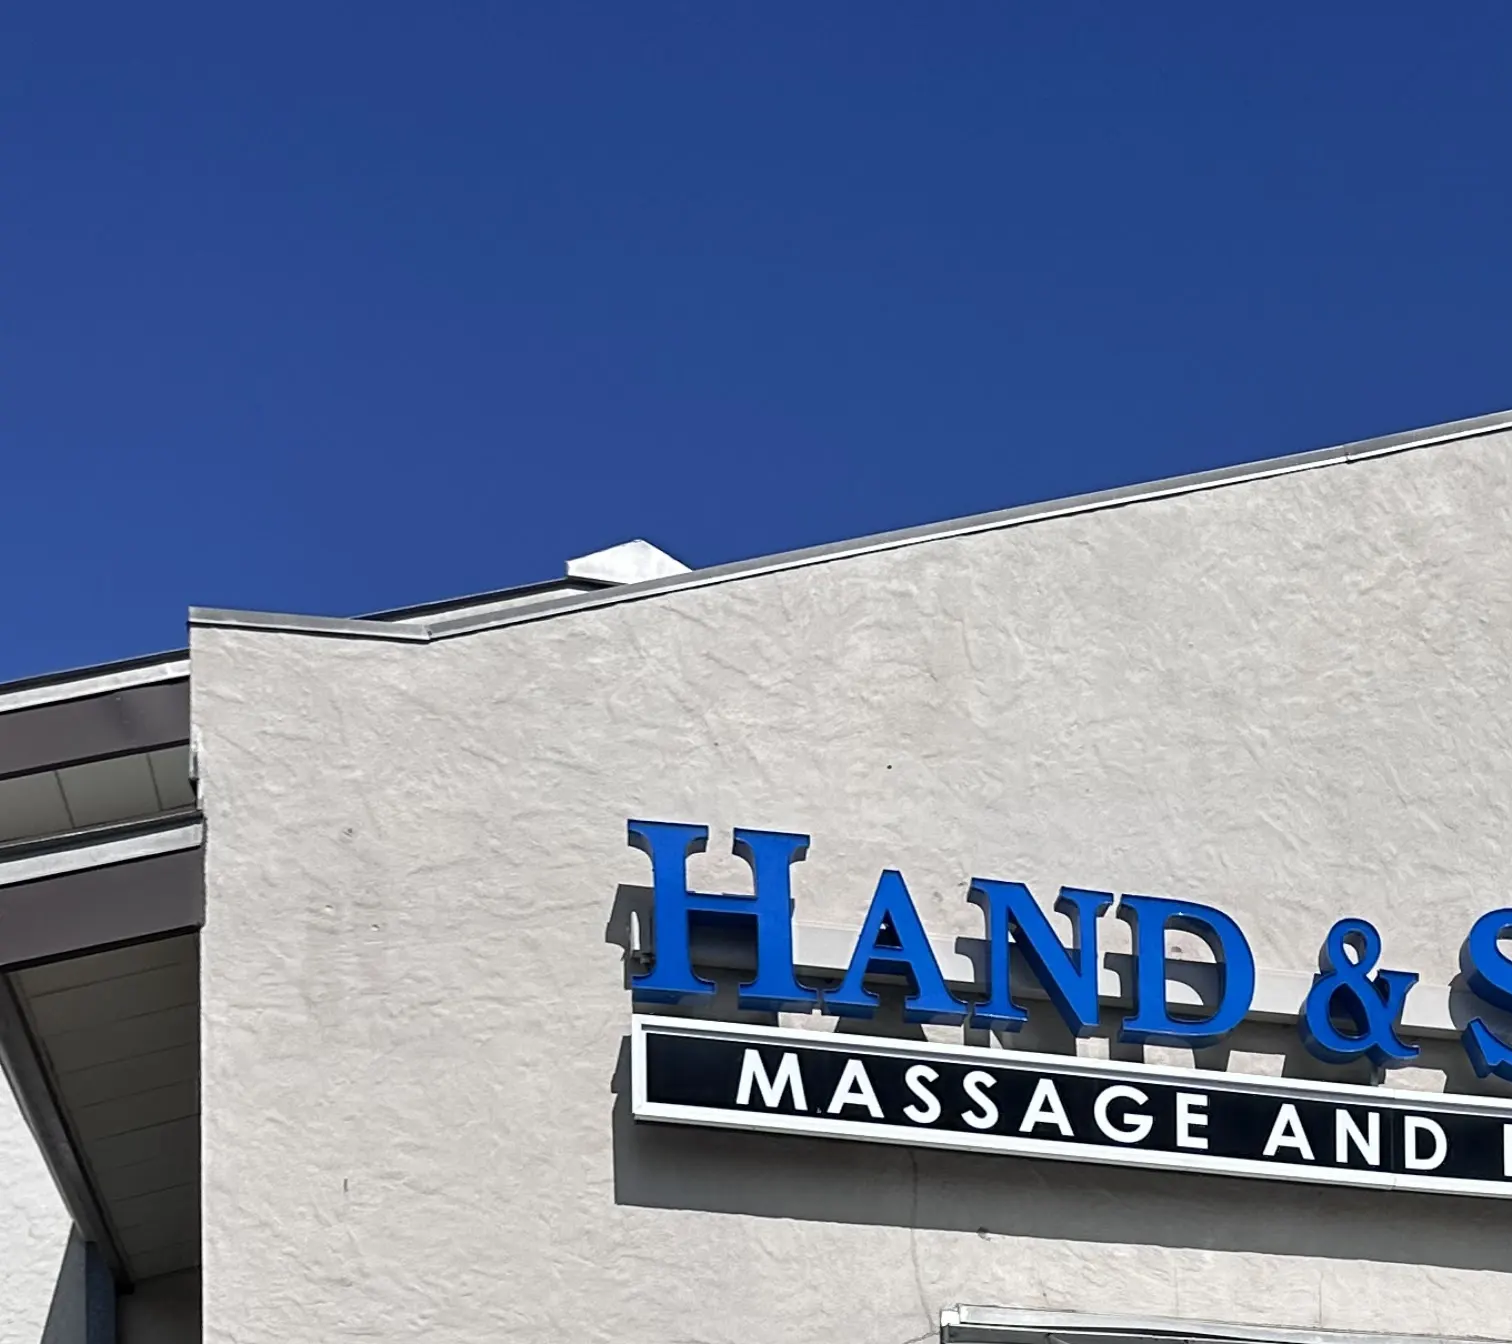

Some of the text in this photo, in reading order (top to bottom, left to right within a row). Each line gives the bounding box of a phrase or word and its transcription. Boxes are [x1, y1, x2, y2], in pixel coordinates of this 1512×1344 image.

[627, 818, 1256, 1050] HAND
[1300, 918, 1419, 1066] &
[736, 1048, 1210, 1150] MASSAGE
[1263, 1103, 1449, 1172] AND
